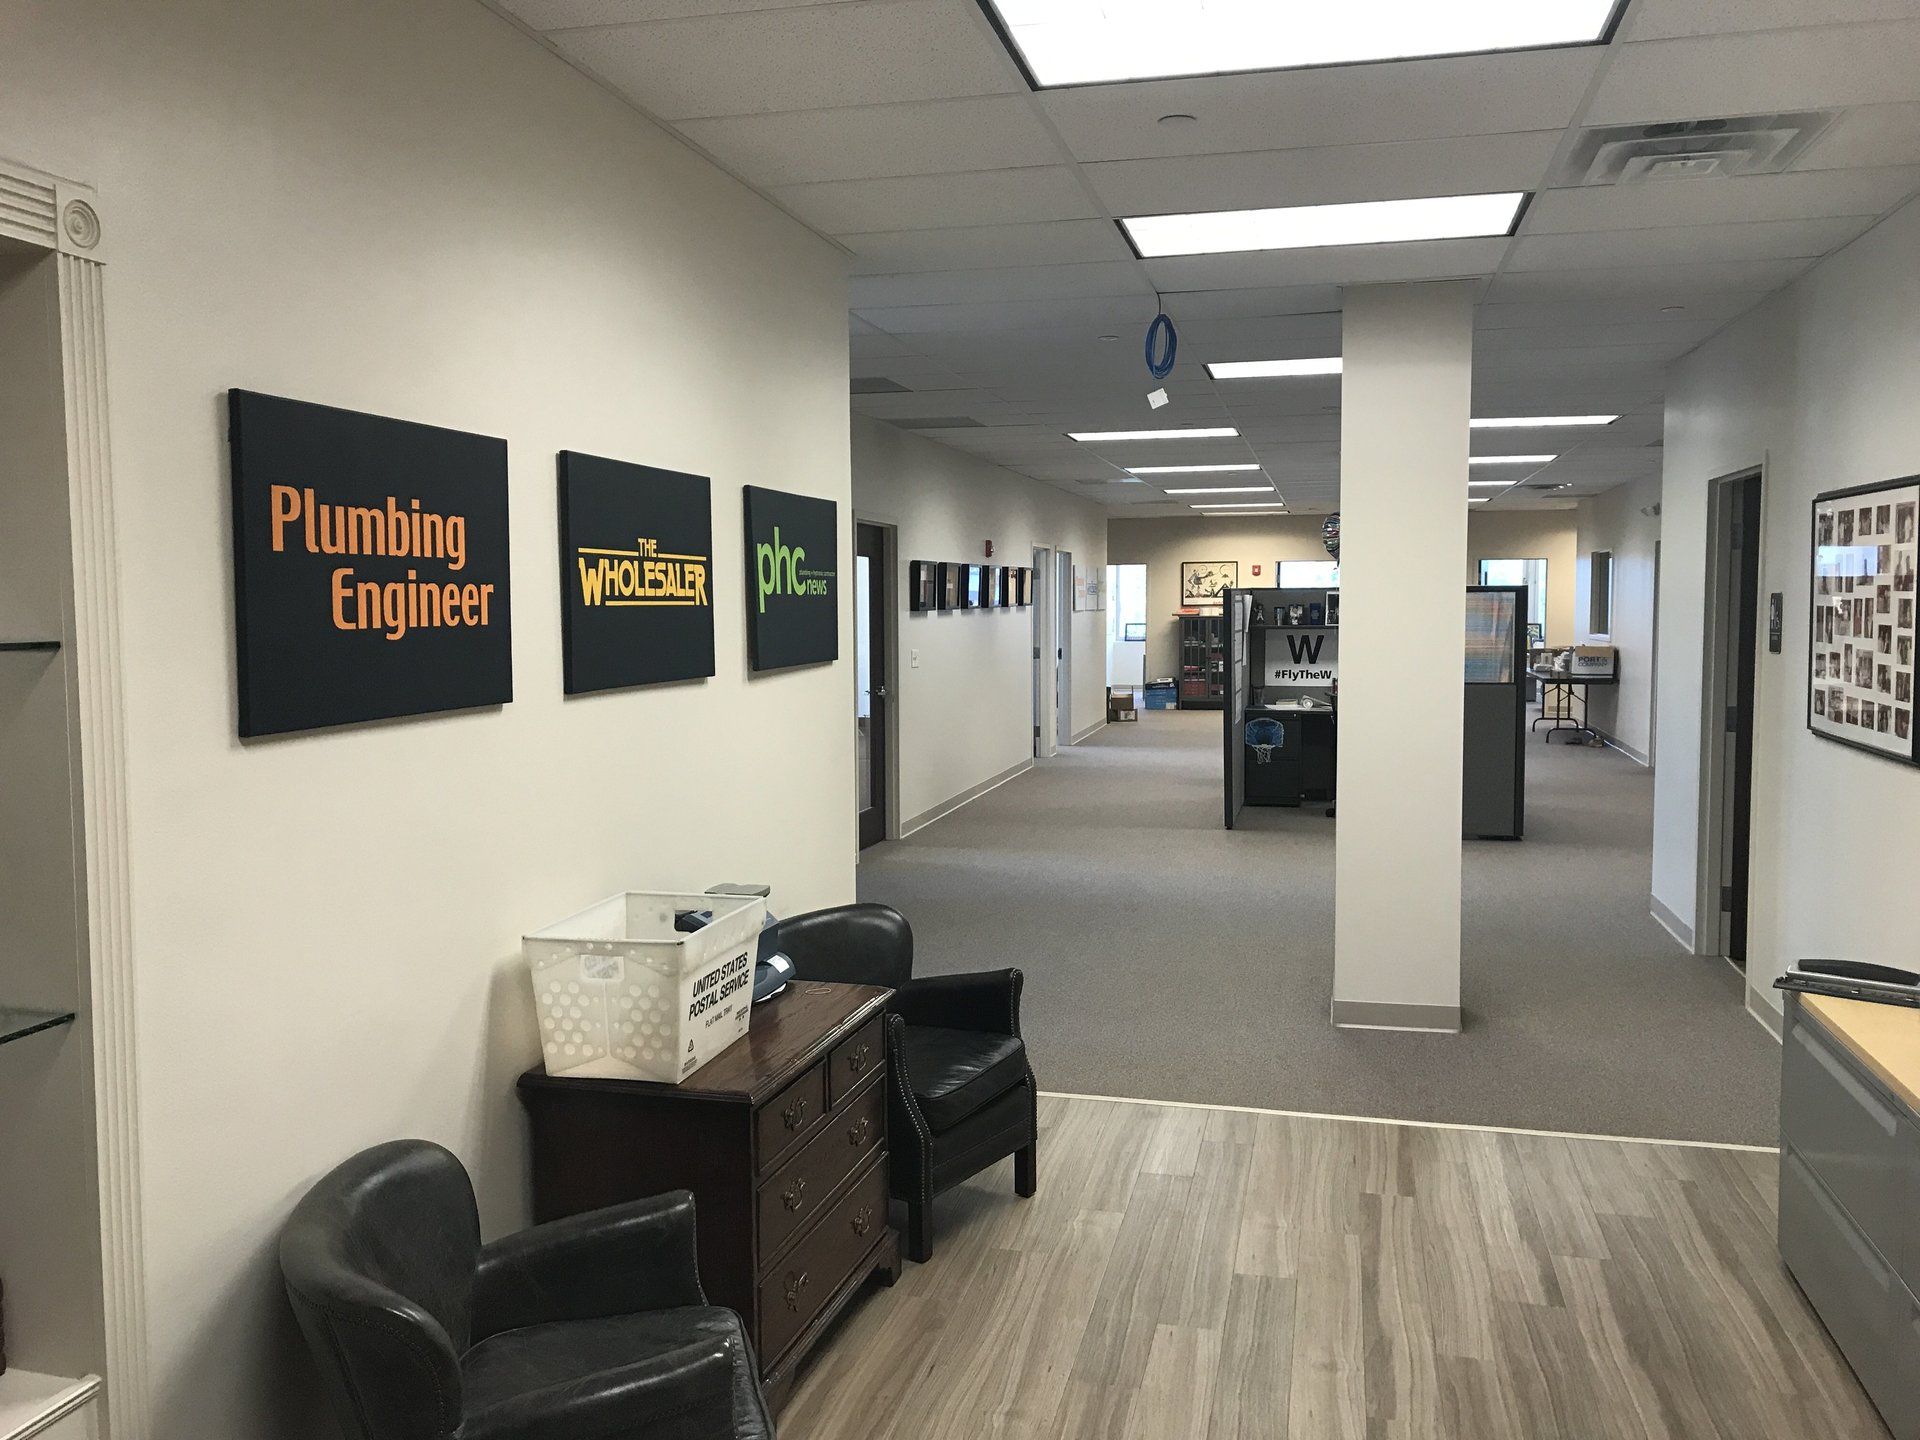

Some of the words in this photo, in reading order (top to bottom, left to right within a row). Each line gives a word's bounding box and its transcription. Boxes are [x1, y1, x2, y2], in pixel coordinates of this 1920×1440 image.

[271, 484, 466, 571] Plumbing
[638, 538, 657, 558] THE
[578, 557, 708, 606] WHOLESALER
[757, 526, 807, 613] phc
[806, 578, 828, 595] news
[331, 567, 494, 641] Engineer
[1286, 634, 1325, 665] W
[1274, 669, 1332, 681] #FlyTheW
[688, 989, 719, 1021] POSTAL
[719, 968, 750, 1001] SERVICE
[692, 968, 720, 998] UNITED
[720, 951, 748, 981] STATES
